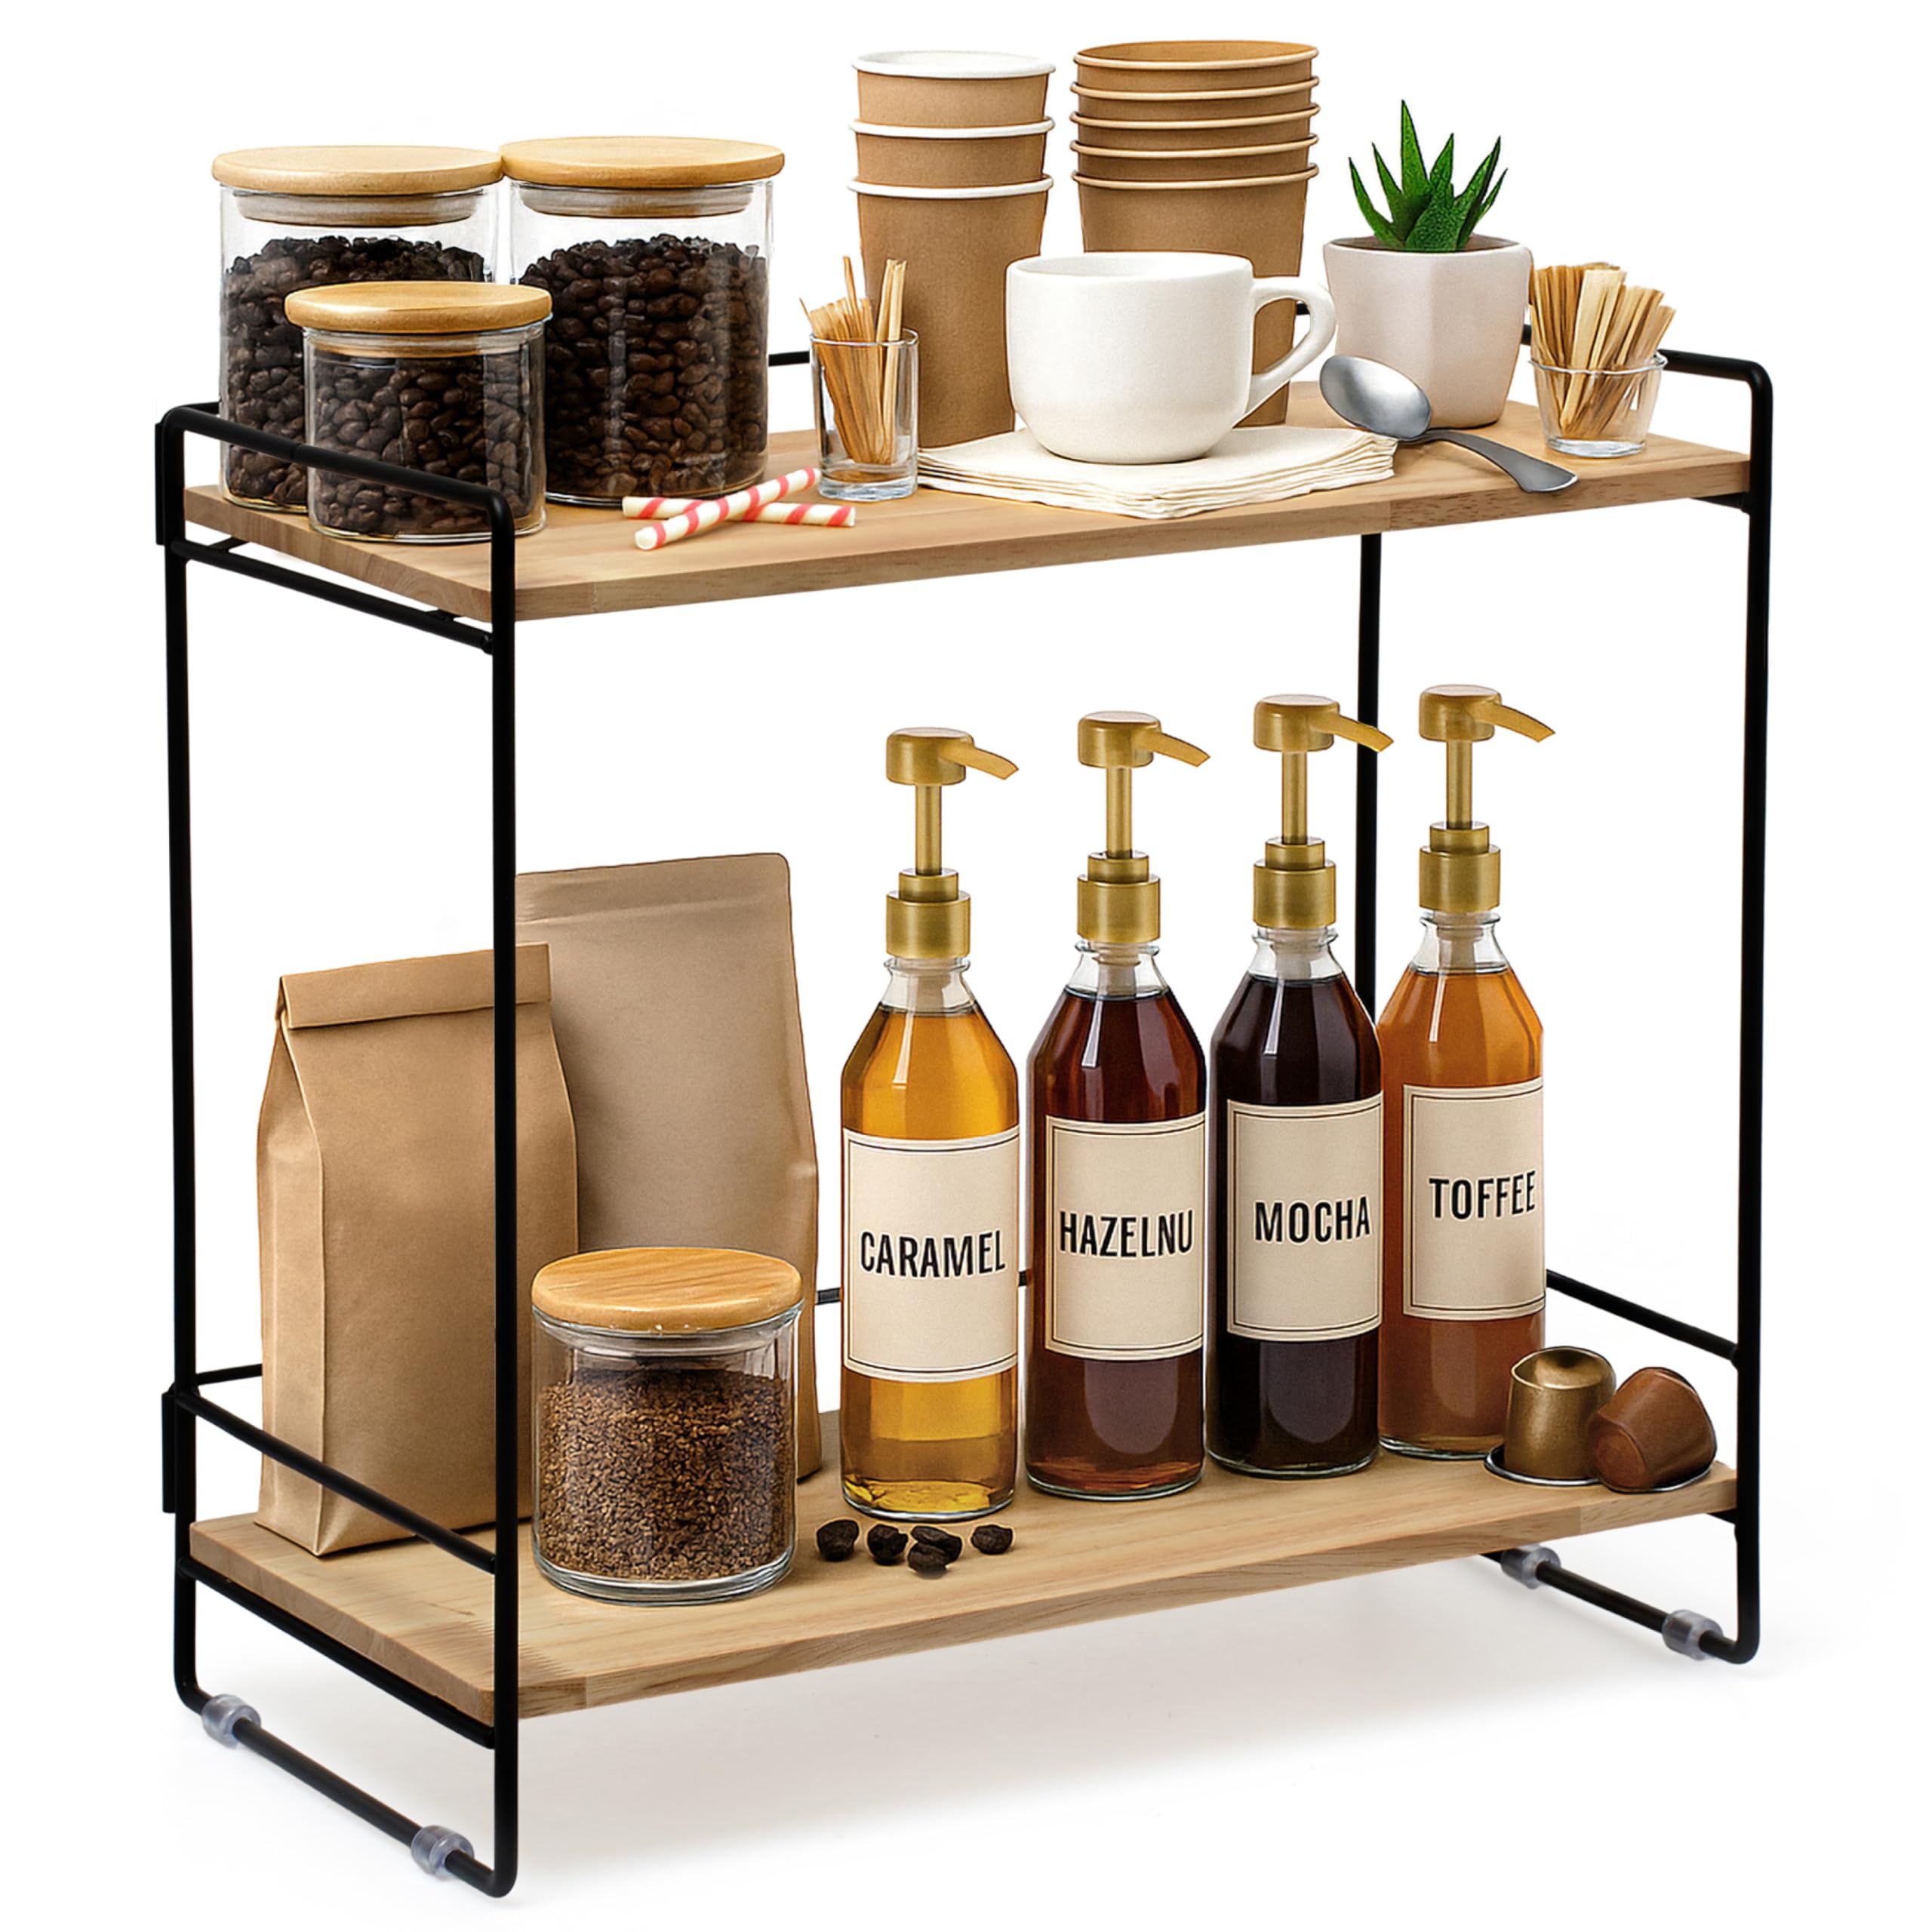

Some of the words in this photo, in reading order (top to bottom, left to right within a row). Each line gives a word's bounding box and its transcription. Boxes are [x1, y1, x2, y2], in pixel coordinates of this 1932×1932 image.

[1254, 1195, 1371, 1244] MOCHA
[1428, 1170, 1537, 1220] TOFFEE
[860, 1230, 1007, 1278] CARAMEL
[1059, 1209, 1193, 1258] HAZELNU
